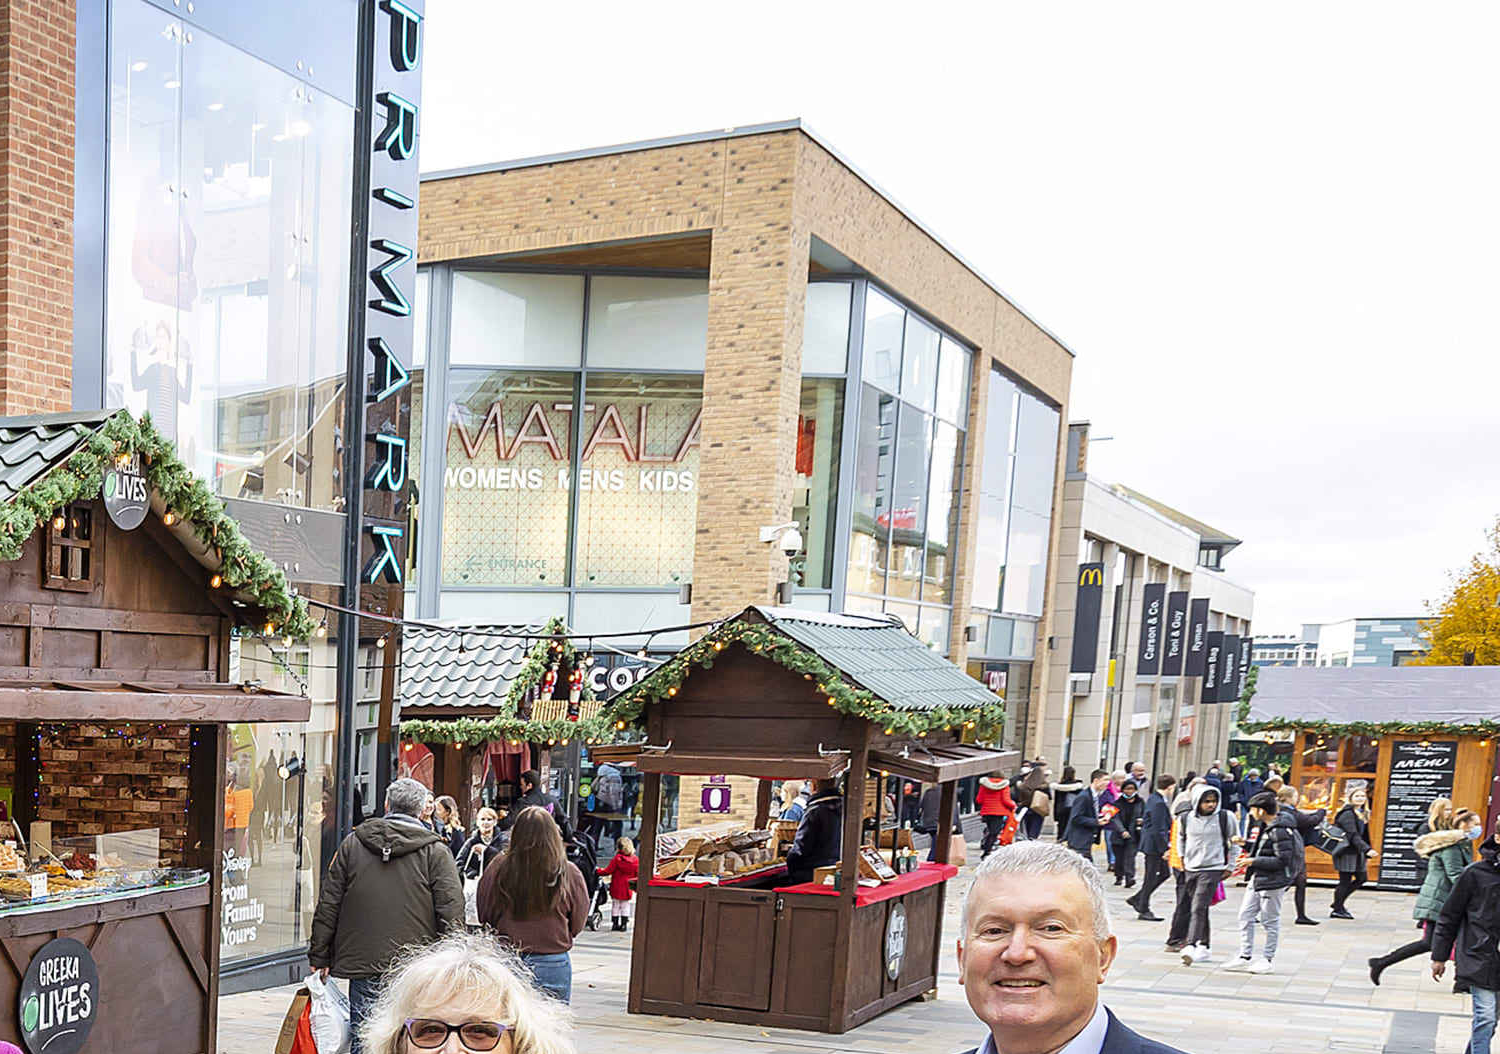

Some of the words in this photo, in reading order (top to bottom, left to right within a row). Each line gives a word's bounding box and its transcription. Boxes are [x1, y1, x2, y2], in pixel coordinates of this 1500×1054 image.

[363, 0, 421, 584] PRIMARK
[444, 467, 542, 490] WOMENS
[639, 470, 694, 492] KIDS
[488, 559, 547, 569] ENTRANCE
[1144, 626, 1156, 660] Carson
[1168, 639, 1180, 657] Toni
[1191, 623, 1203, 651] Ryman
[225, 898, 264, 924] Family
[222, 926, 257, 946] Yours
[39, 956, 80, 987] GREEKA
